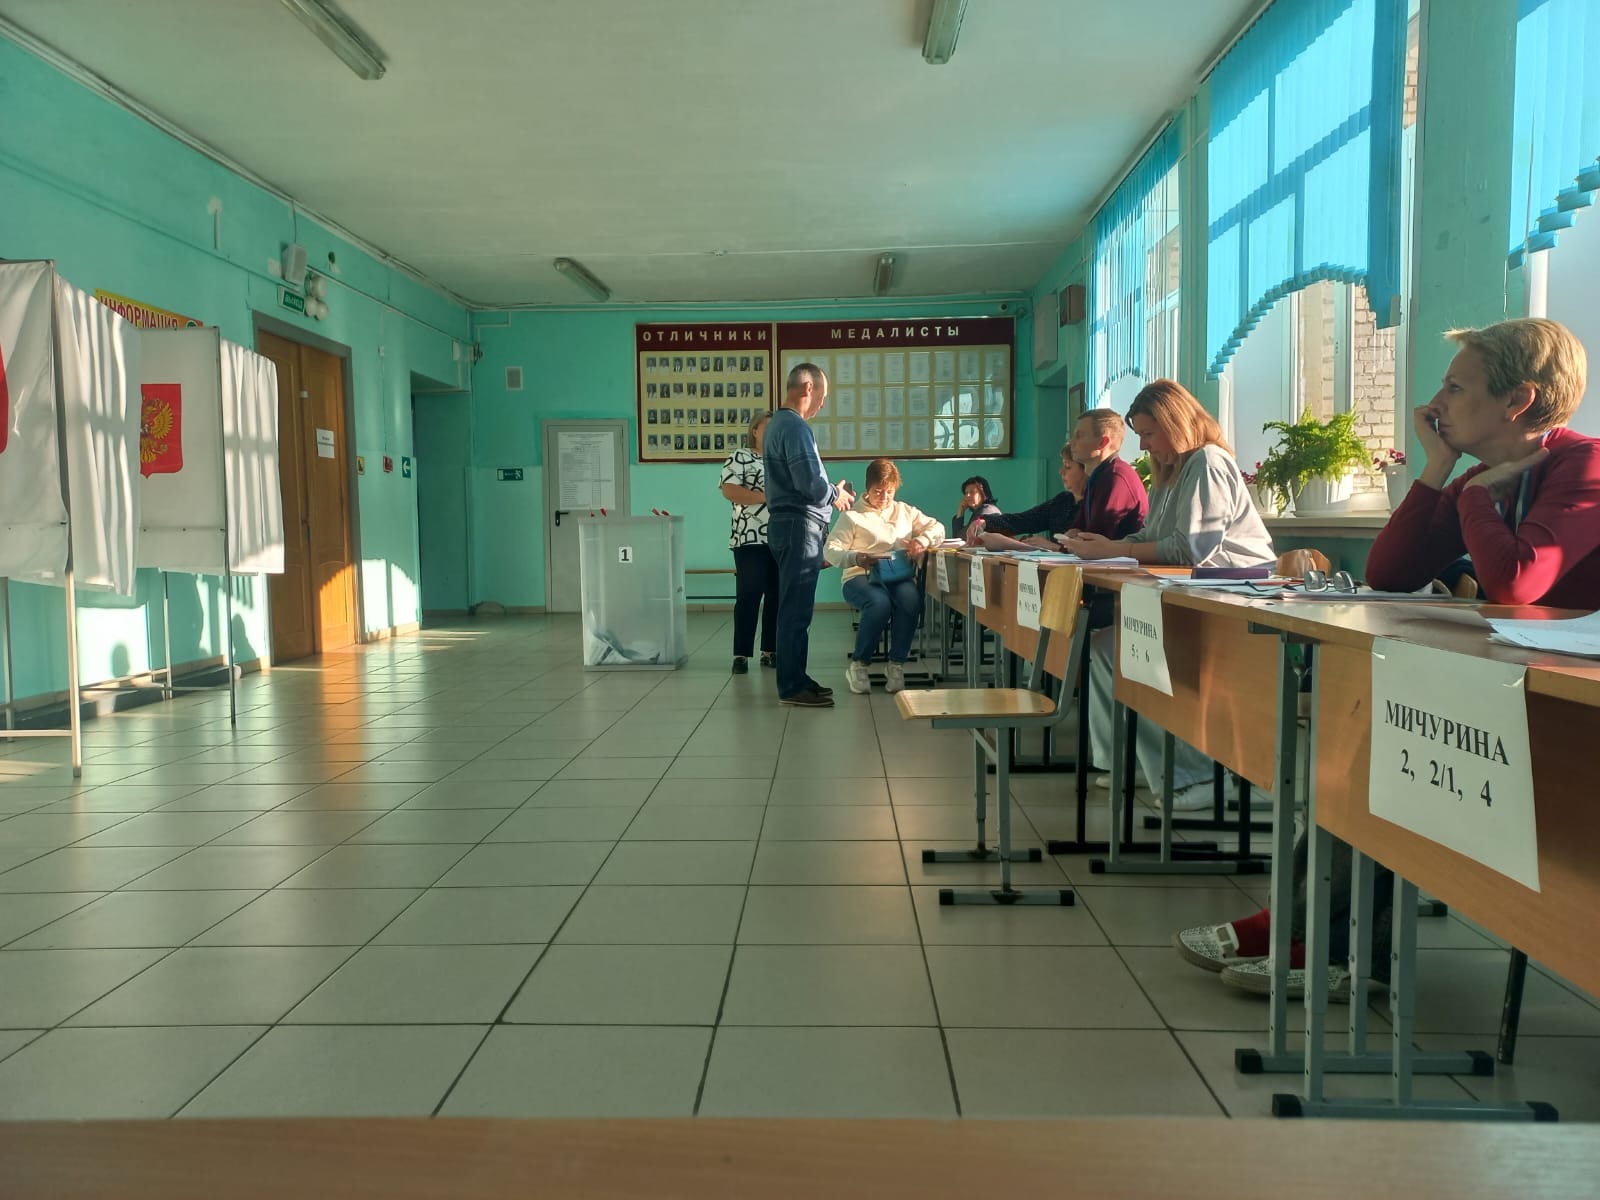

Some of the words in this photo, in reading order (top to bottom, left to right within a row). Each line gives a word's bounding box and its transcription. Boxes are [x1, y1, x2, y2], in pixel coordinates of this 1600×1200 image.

[642, 330, 766, 342] ОТЛИЧНИКИ
[831, 326, 960, 340] МЕДАЛИСТЫ
[621, 549, 630, 561] 1
[1123, 615, 1157, 640] МИЧУРИНА
[1385, 699, 1510, 766] МИЧУРИНА
[1401, 748, 1415, 782] 2,
[1430, 760, 1463, 802] 2/1,
[1480, 780, 1492, 808] 4
